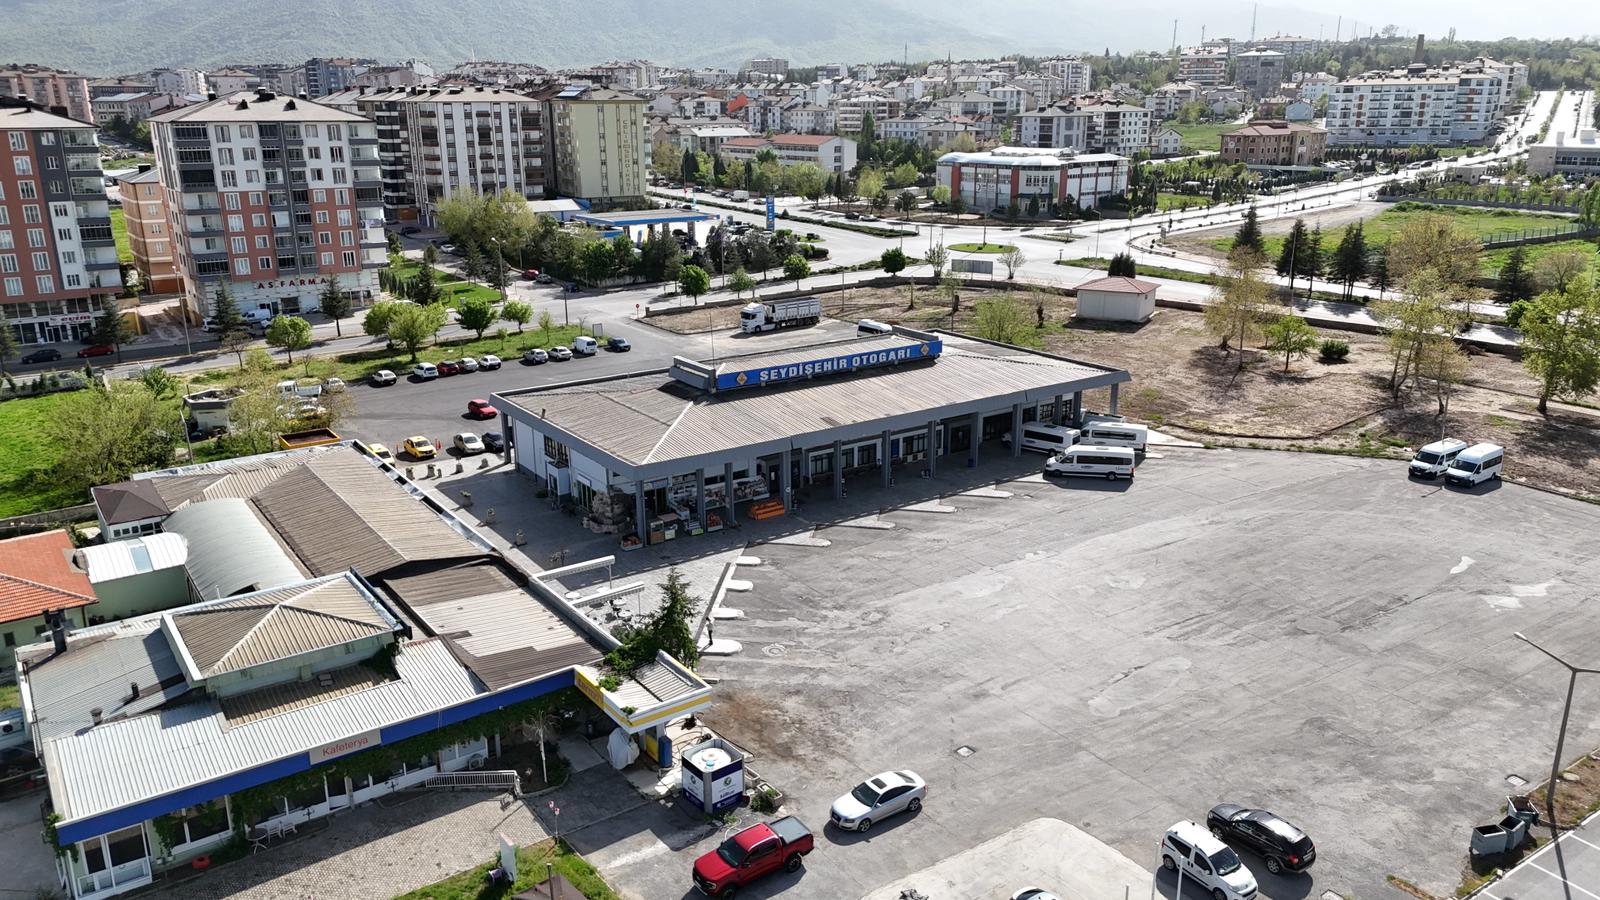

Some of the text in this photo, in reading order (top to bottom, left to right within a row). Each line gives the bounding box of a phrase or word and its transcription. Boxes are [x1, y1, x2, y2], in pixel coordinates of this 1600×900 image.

[280, 278, 327, 287] FARMA
[759, 348, 911, 382] SEYDİŞEHİR OTOGARI
[322, 737, 368, 756] Kafeterya
